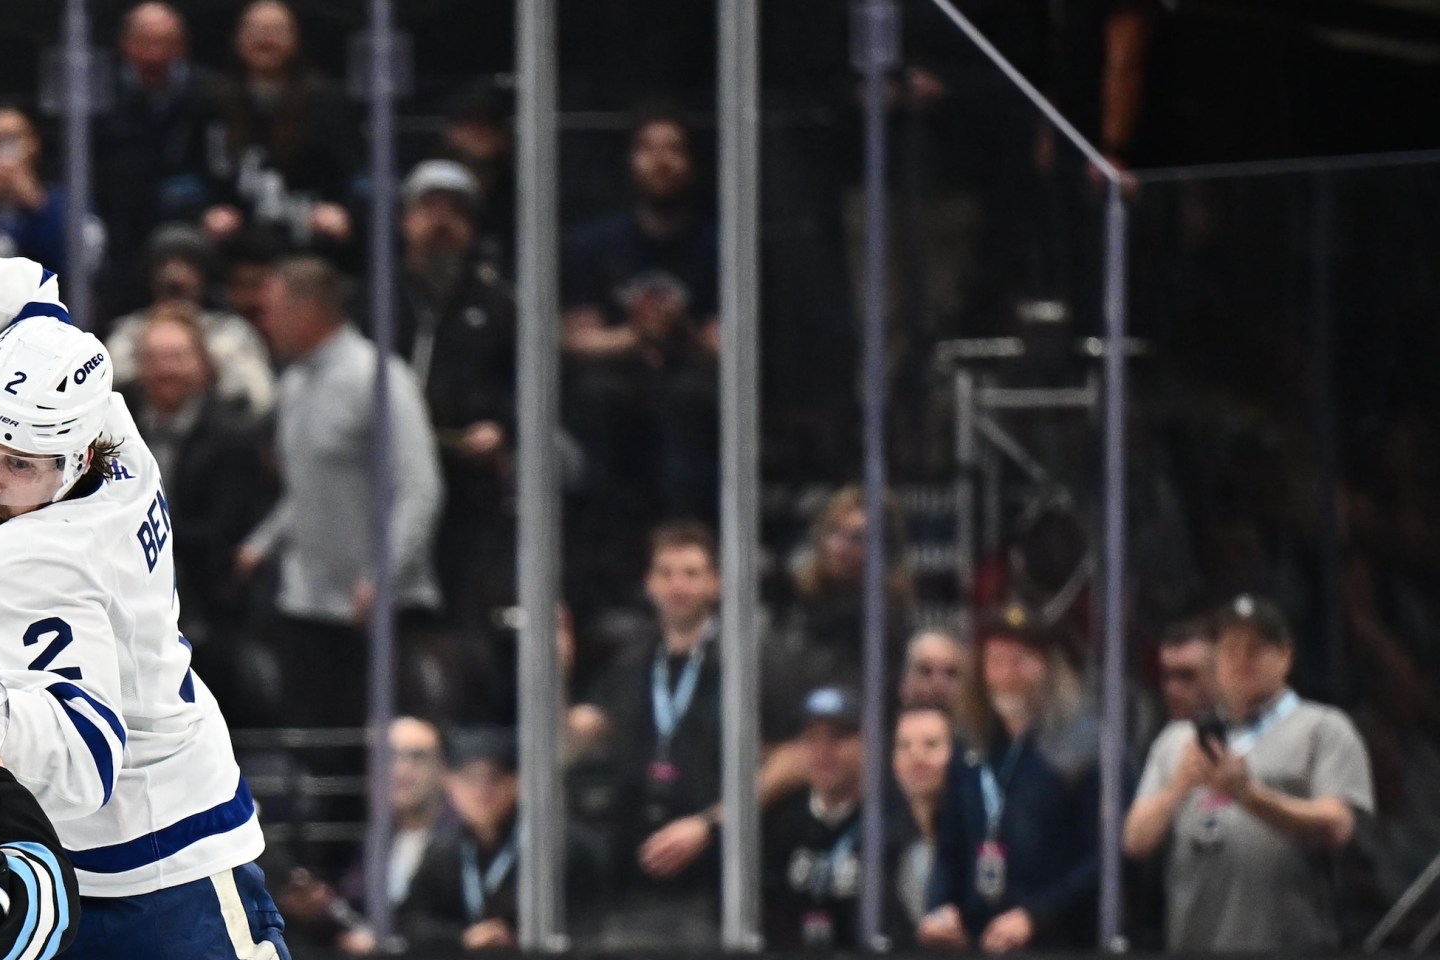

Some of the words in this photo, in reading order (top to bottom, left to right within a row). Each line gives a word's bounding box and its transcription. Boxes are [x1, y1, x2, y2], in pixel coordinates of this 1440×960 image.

[4, 371, 27, 395] 2
[74, 353, 105, 385] OREO
[22, 616, 83, 680] 2
